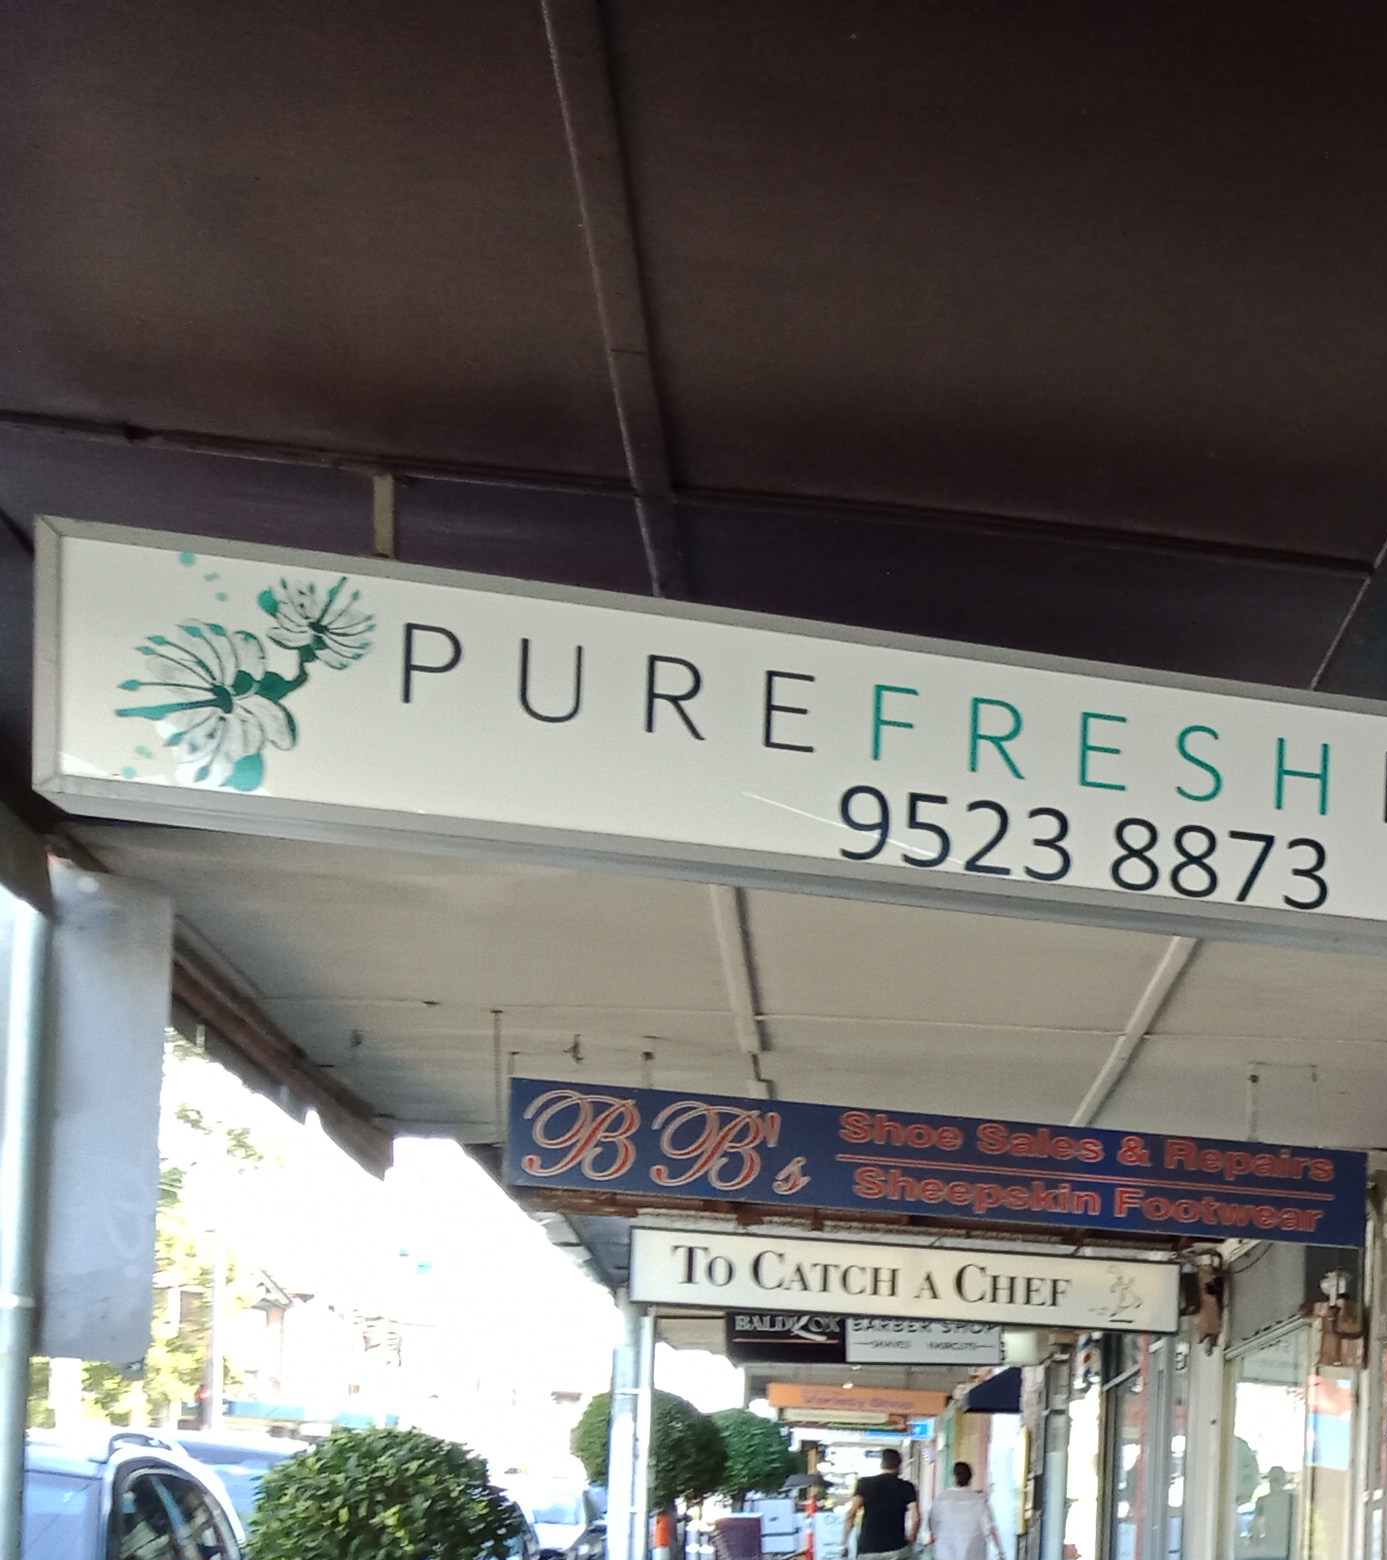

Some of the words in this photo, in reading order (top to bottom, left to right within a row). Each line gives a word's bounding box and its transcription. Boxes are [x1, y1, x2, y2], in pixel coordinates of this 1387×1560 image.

[838, 784, 1072, 881] 9523
[1110, 817, 1330, 910] 8873
[839, 1110, 964, 1151] Shoe
[977, 1122, 1106, 1163] Sales
[1117, 1135, 1152, 1168] &
[1164, 1138, 1335, 1182] Repairs
[853, 1166, 1101, 1215] Sheepskin
[1114, 1186, 1324, 1233] Footwear
